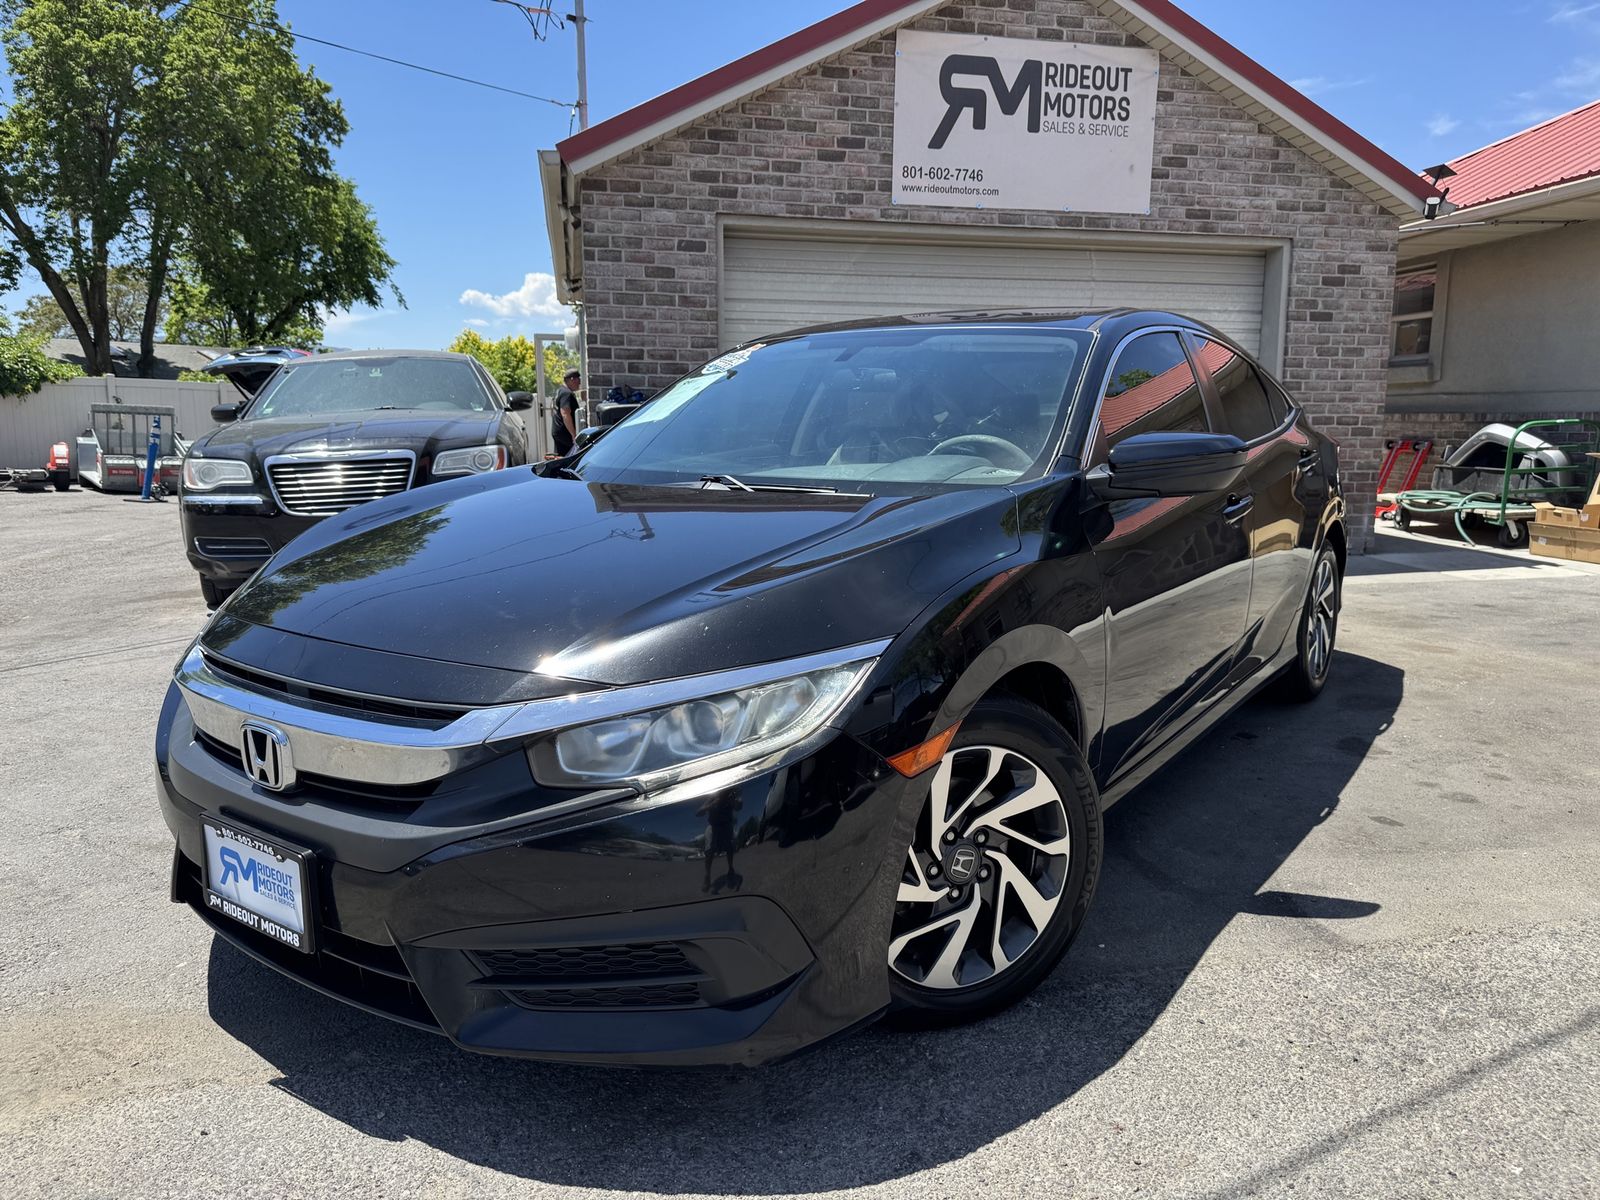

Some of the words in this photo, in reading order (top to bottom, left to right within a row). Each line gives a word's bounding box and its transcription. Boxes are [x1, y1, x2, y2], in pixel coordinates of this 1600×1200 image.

[1045, 62, 1132, 92] RIDEOUT
[1043, 92, 1131, 122] MOTORS
[1042, 121, 1075, 135] SALES
[1078, 122, 1086, 135] &
[1088, 123, 1129, 137] SERVICE
[902, 165, 983, 182] 801-602-7746
[901, 184, 999, 196] www.rideoutmotors.com
[221, 827, 275, 856] 801-602-7746
[257, 862, 293, 887] RIDEOUT
[258, 877, 295, 902] MOTORS
[223, 900, 259, 928] RIDEOUT
[261, 918, 300, 947] MOTORS
